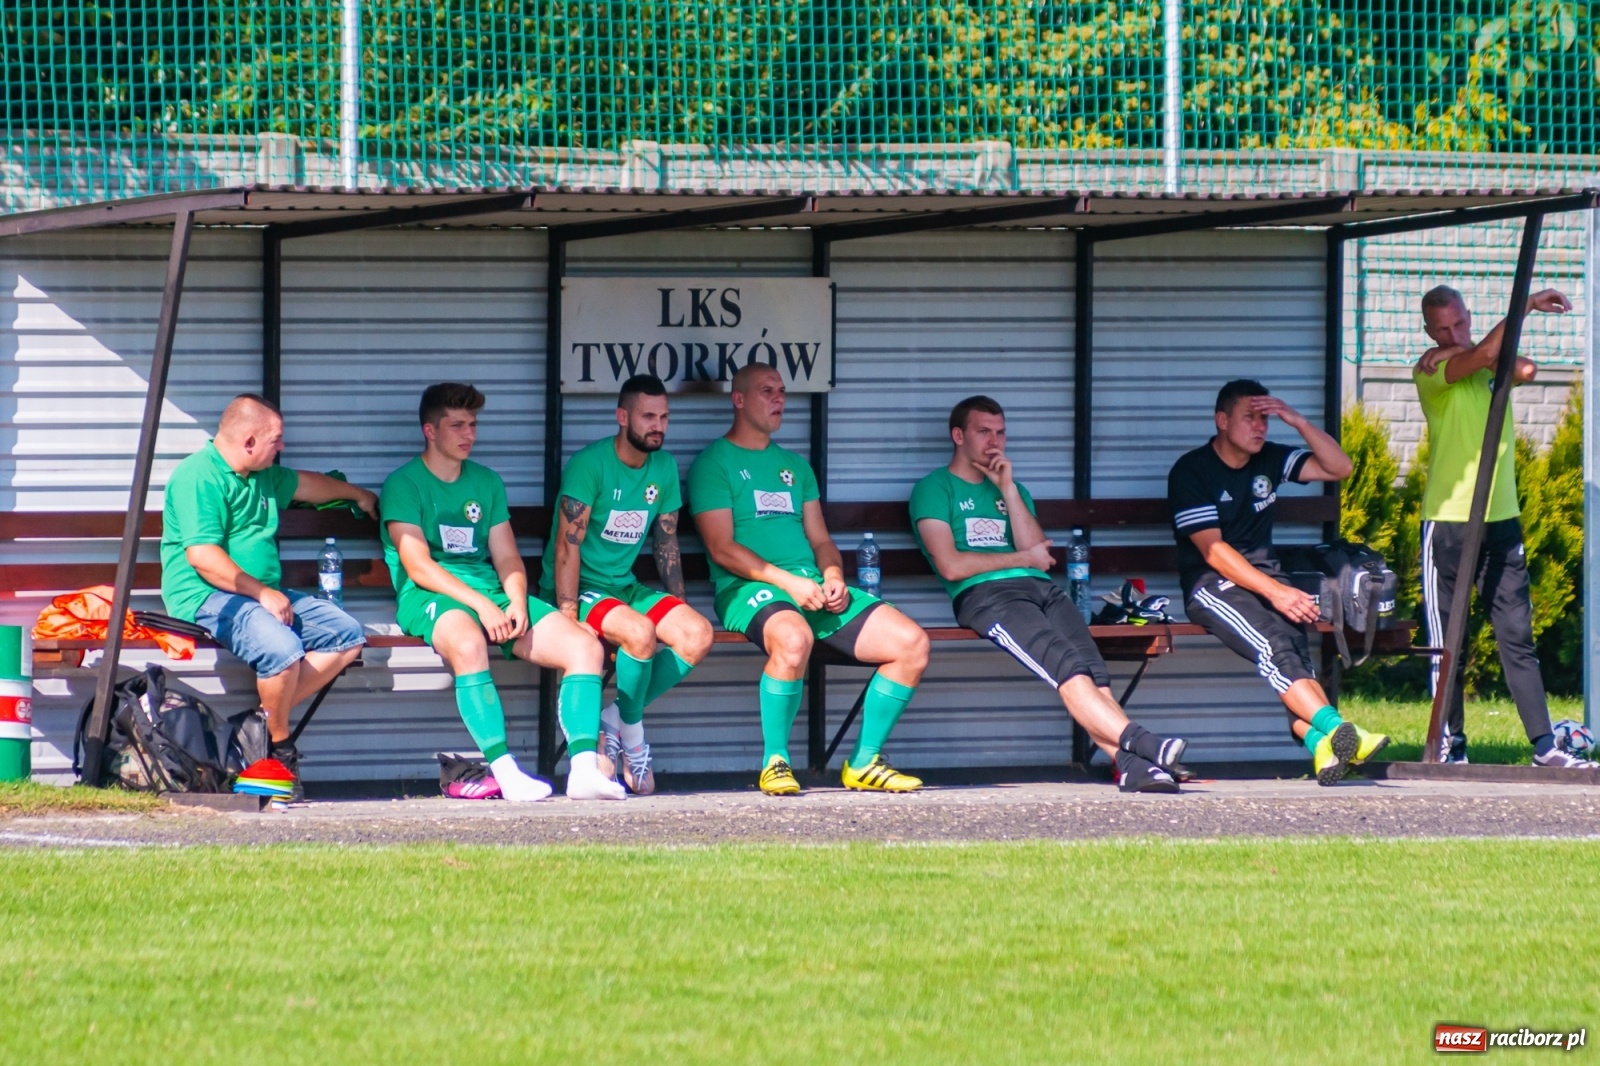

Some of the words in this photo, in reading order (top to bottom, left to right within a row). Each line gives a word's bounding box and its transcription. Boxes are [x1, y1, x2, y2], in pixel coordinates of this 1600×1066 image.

[657, 287, 742, 328] LKS
[572, 327, 821, 383] TWORKÓW
[739, 468, 752, 481] 10
[612, 488, 622, 502] 11
[578, 590, 602, 604] 11
[746, 589, 774, 609] 10
